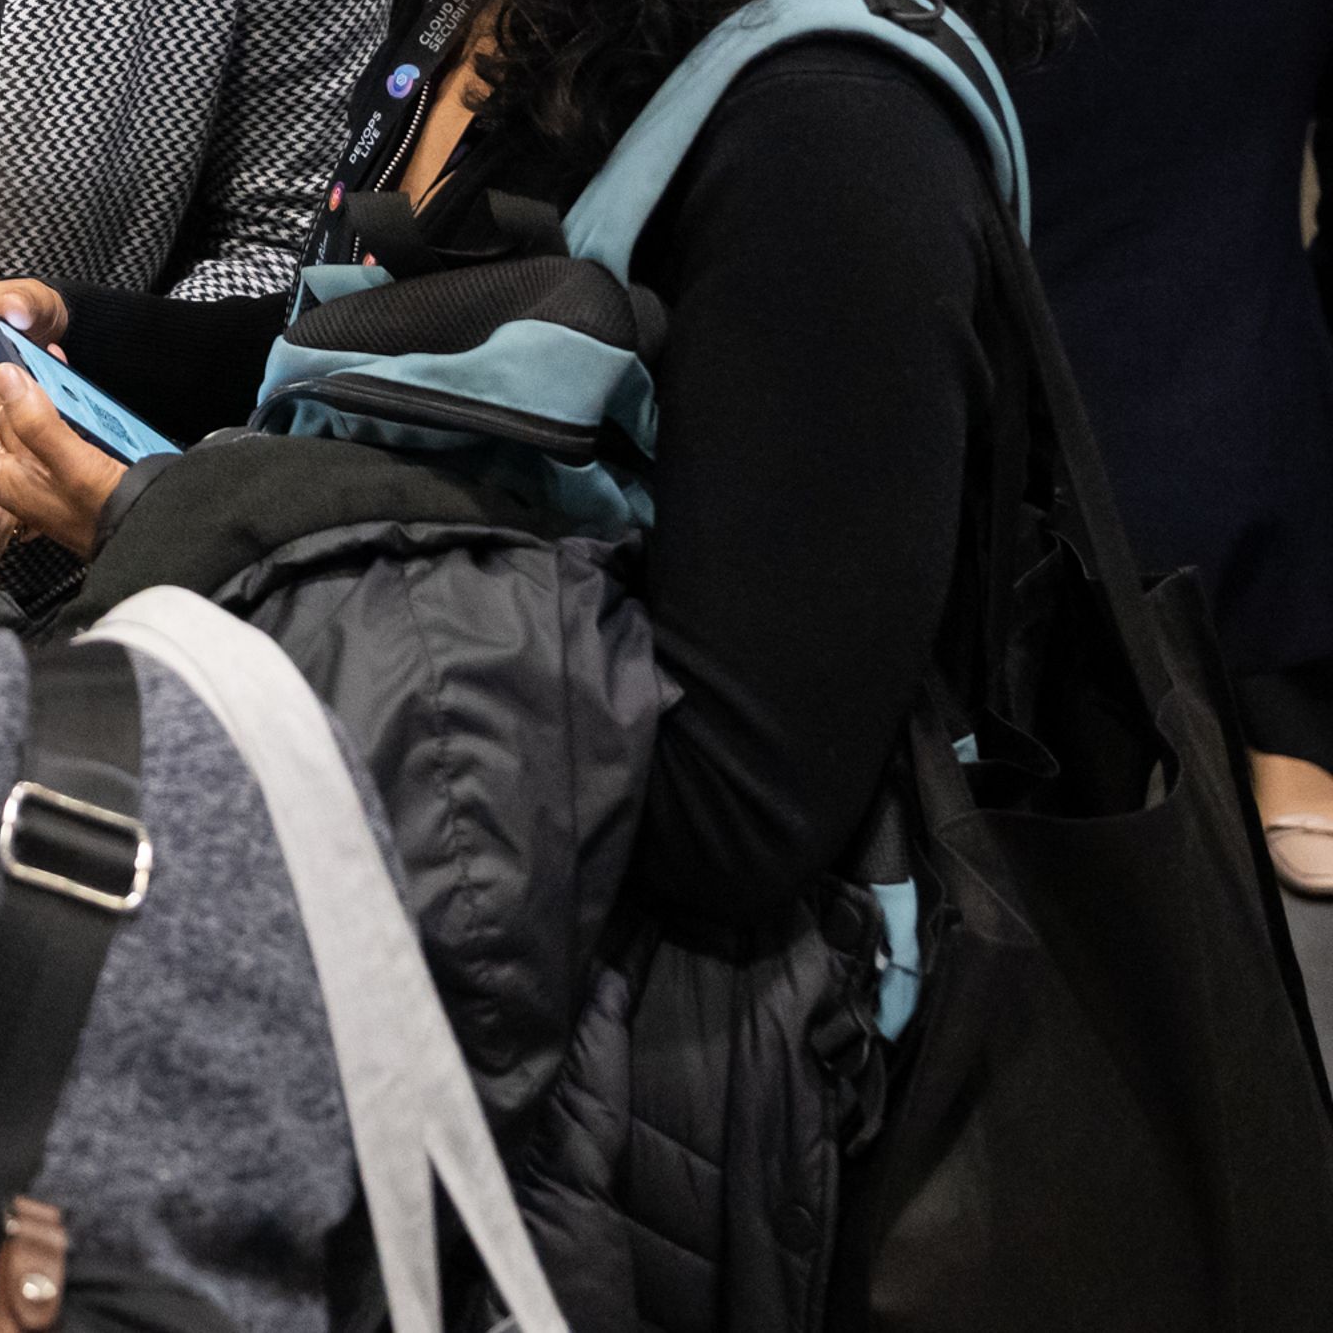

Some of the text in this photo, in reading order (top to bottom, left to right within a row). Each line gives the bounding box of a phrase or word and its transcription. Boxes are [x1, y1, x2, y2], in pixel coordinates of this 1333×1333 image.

[419, 2, 454, 46] CLOUD
[349, 110, 382, 164] DEVOPS
[361, 129, 381, 159] LIVE
